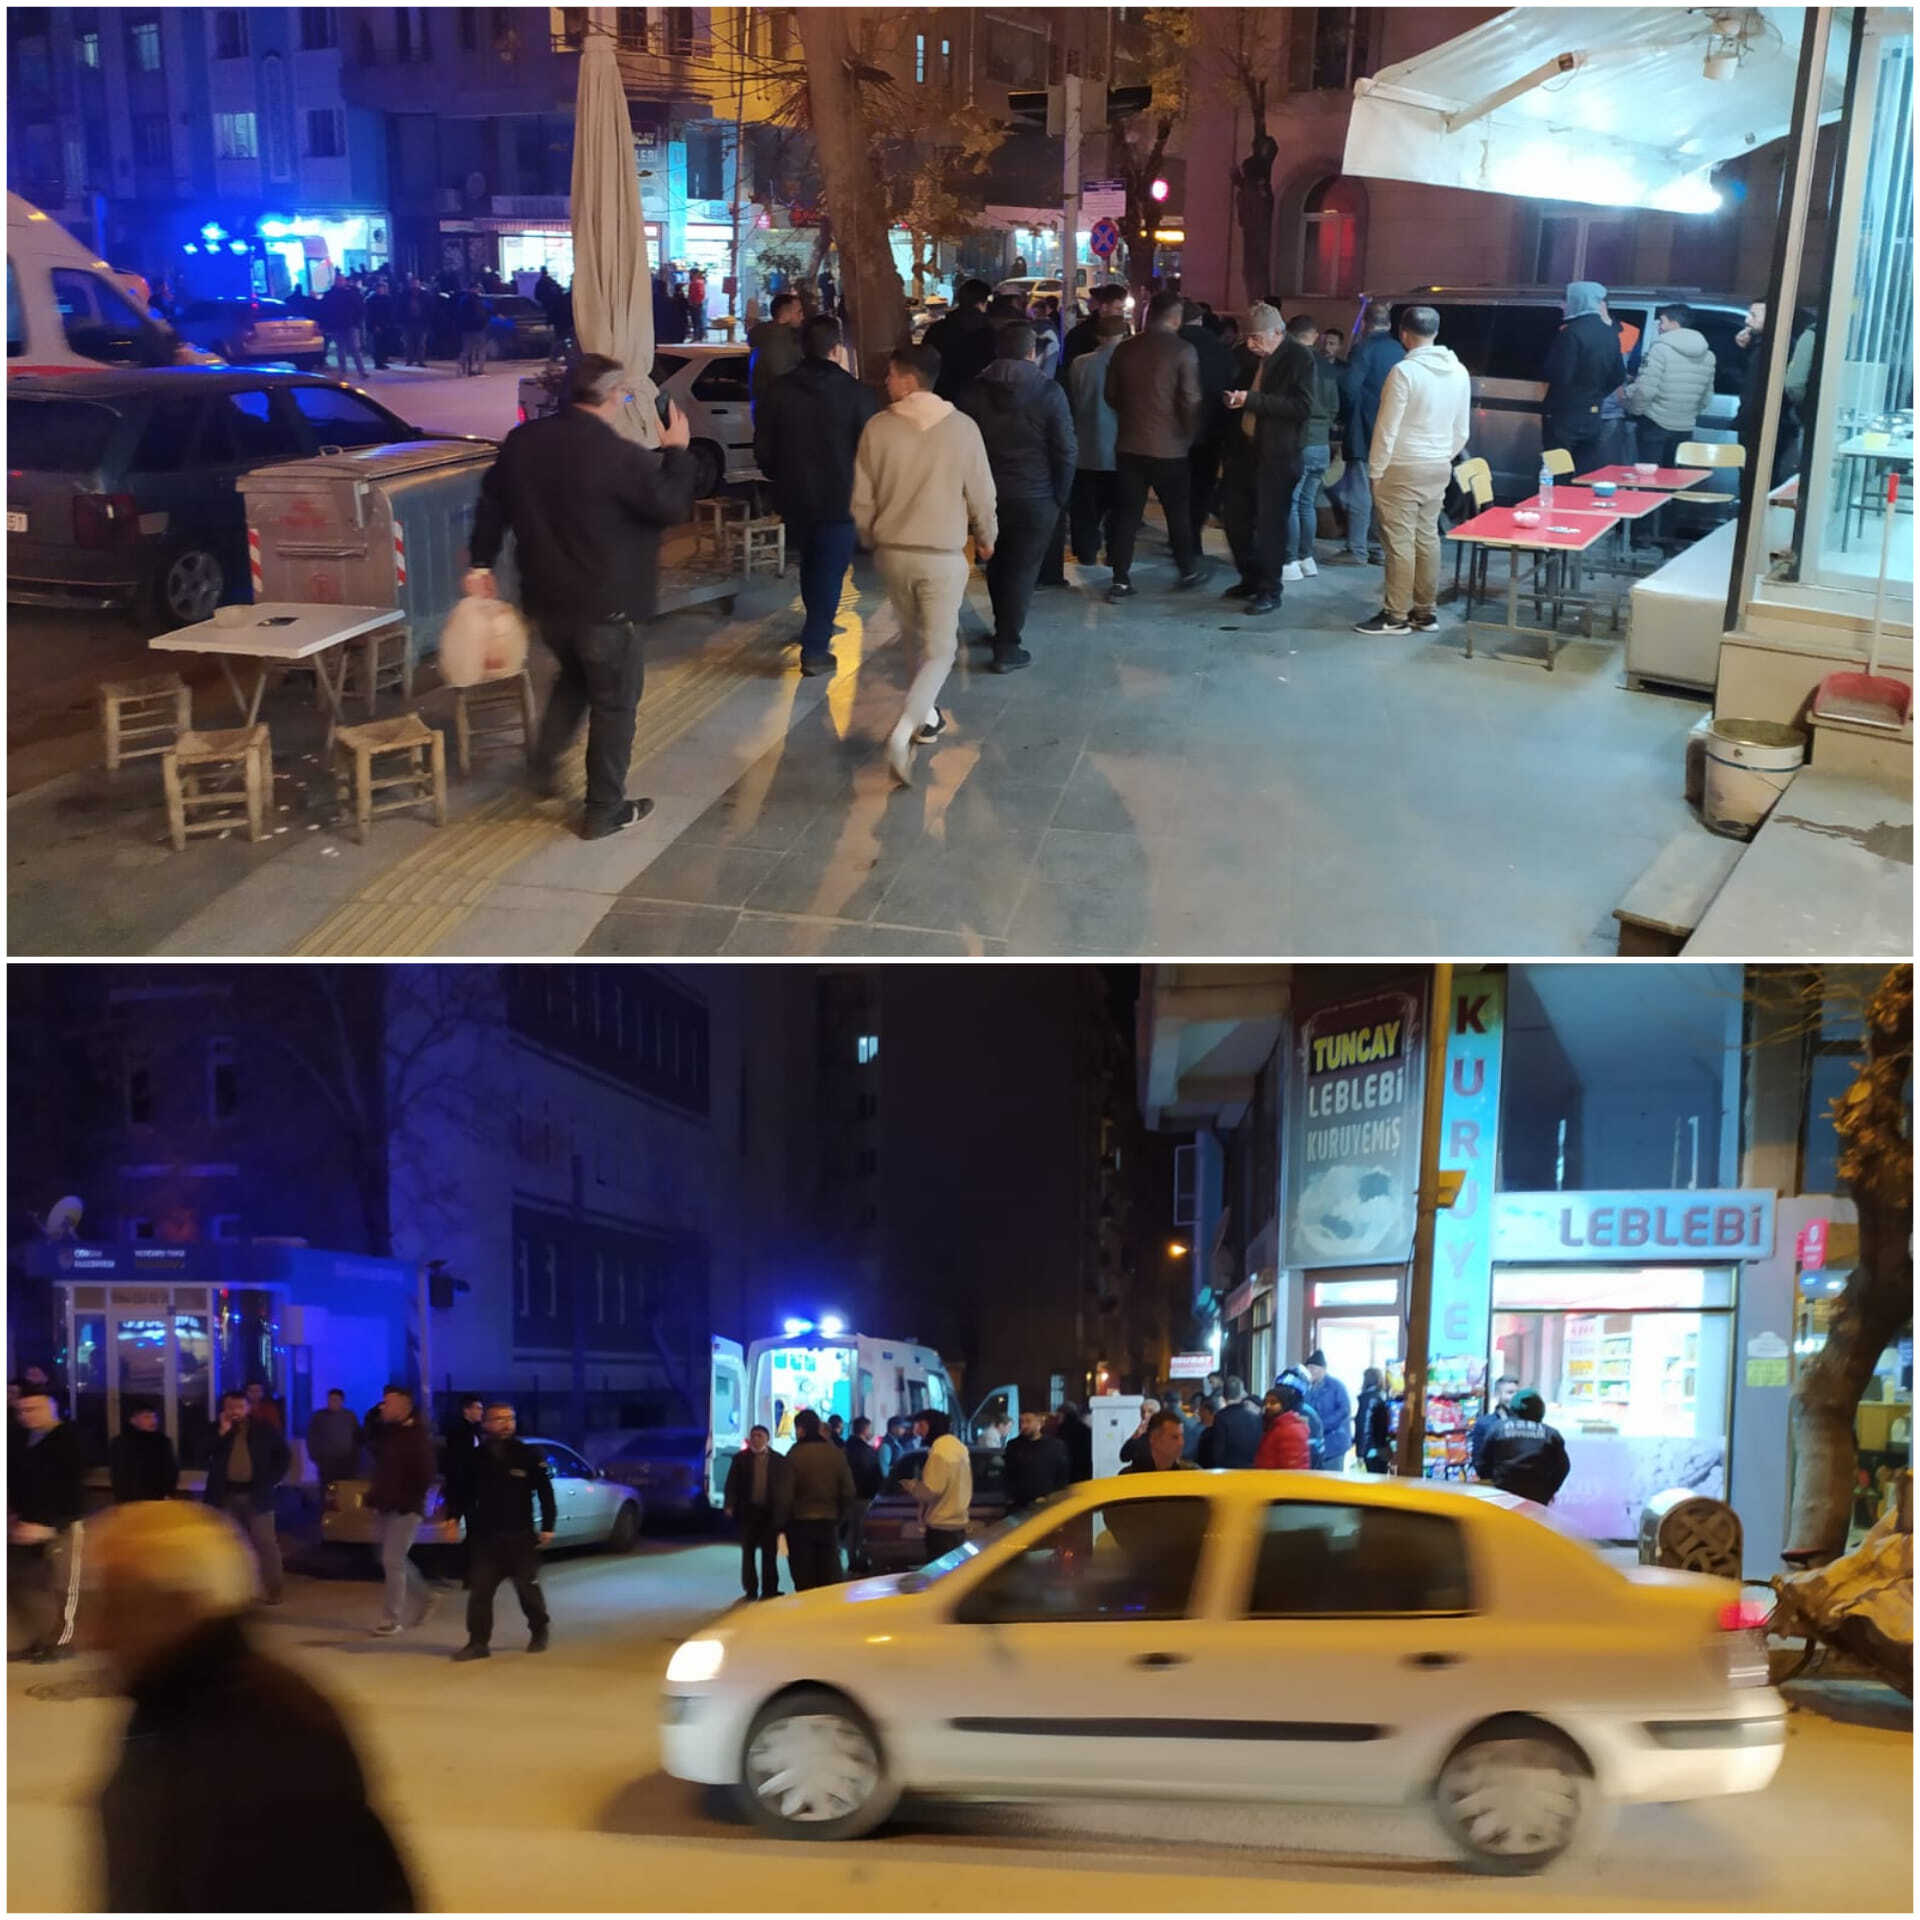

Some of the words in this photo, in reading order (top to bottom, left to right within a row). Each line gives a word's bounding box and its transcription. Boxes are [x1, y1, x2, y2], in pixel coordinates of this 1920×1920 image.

[1312, 1019, 1401, 1073] TUNCAY
[1308, 1066, 1404, 1119] LEBLEBİ
[1306, 1115, 1402, 1164] KURUYEMİŞ
[1559, 1204, 1762, 1248] LEBLEBİ
